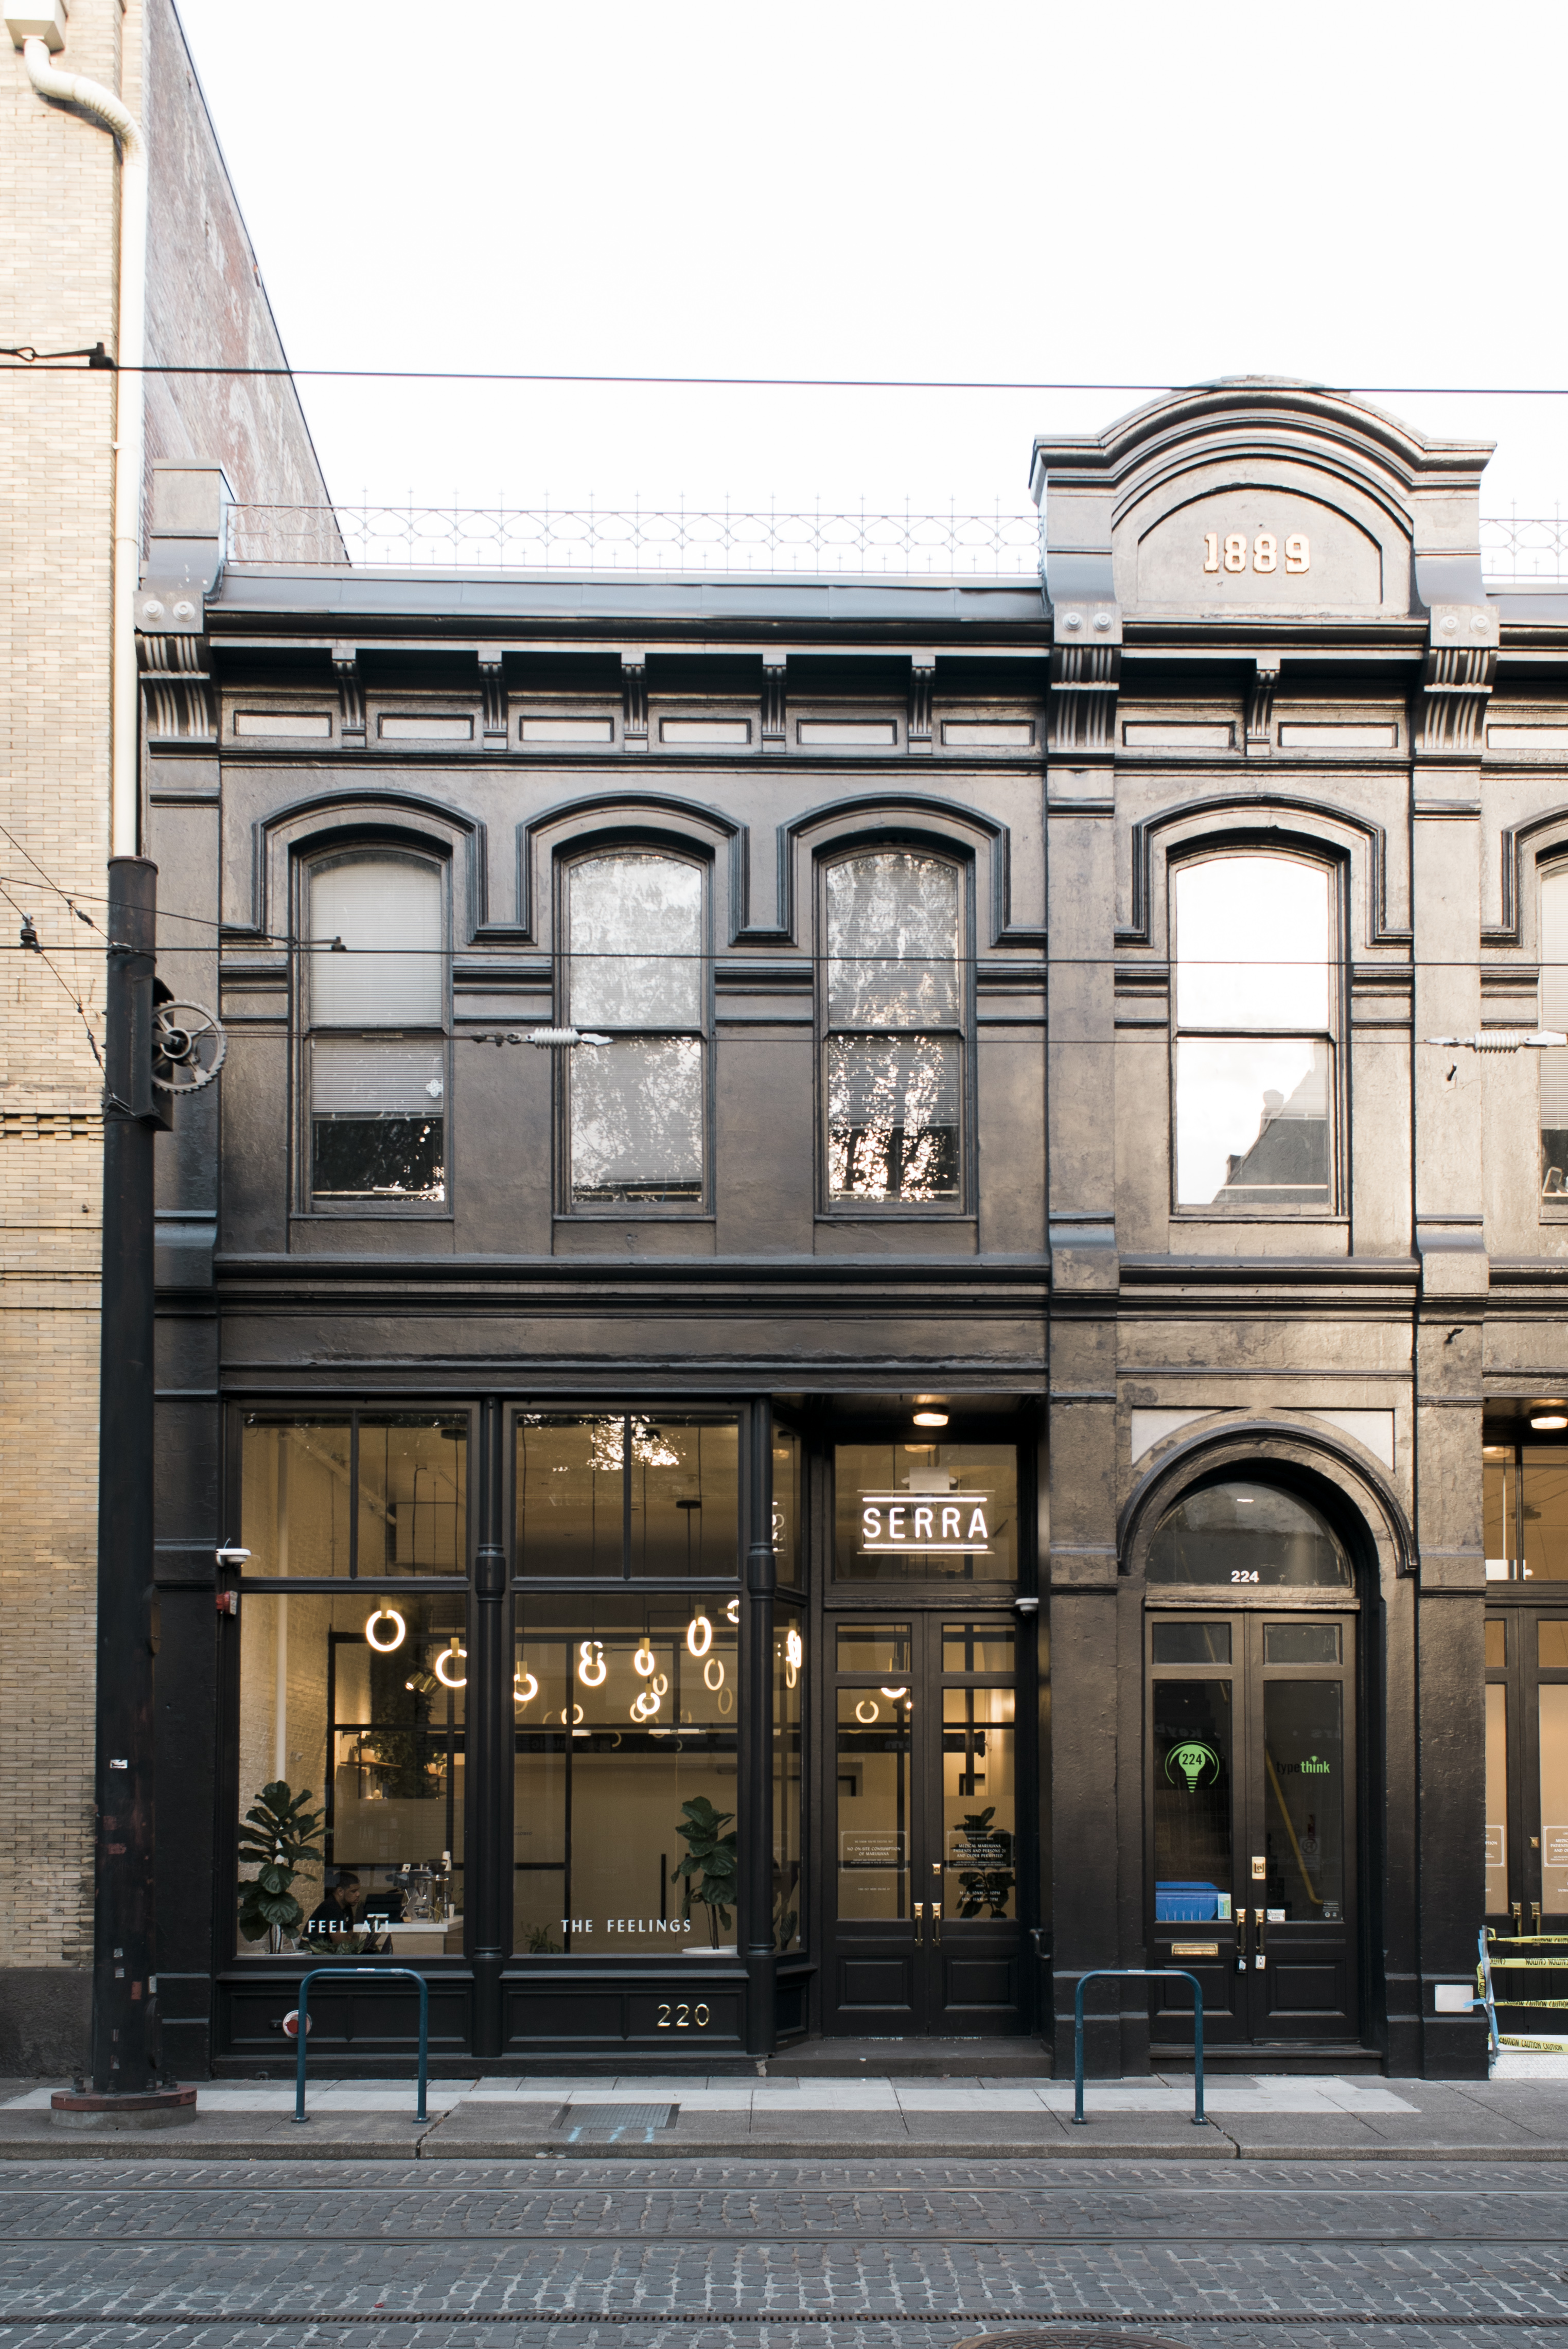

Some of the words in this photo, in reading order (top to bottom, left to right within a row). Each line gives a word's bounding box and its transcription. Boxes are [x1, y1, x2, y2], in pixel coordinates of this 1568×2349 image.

[1204, 533, 1310, 573] 1889
[862, 1507, 988, 1538] SERRA
[1231, 1570, 1259, 1583] 224
[1182, 1754, 1203, 1765] 224
[308, 1920, 347, 1933] FEEL
[361, 1920, 393, 1933] ALL
[560, 1919, 593, 1933] THE
[607, 1919, 691, 1933] FEELINGS
[657, 2004, 710, 2027] 220
[1499, 2036, 1519, 2046] CAUTION
[1521, 2040, 1541, 2049] CAUTION
[1542, 2042, 1563, 2052] CAUTION
